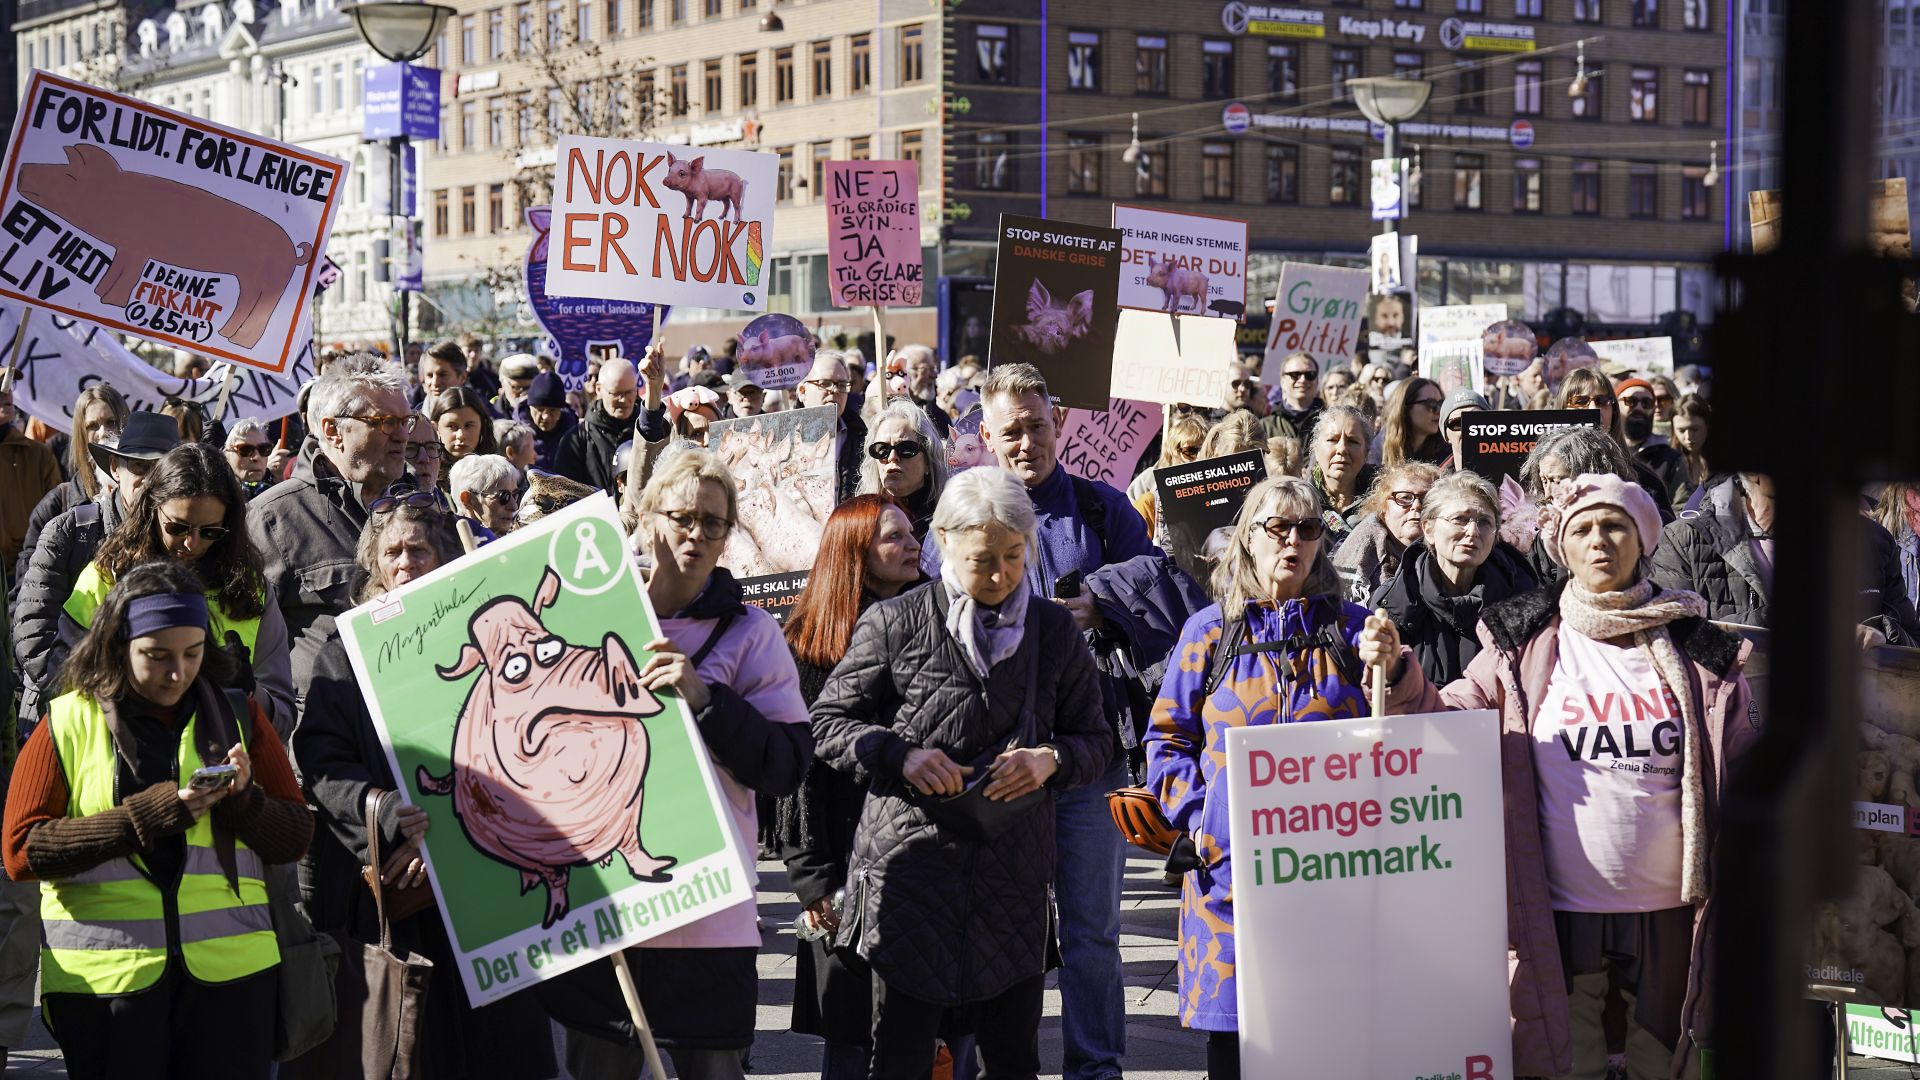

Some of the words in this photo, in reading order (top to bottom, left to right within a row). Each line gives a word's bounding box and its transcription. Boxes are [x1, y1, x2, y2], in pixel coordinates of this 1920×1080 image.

[1339, 15, 1380, 40] Keep
[1381, 18, 1395, 37] it
[1396, 20, 1425, 43] dry
[32, 87, 107, 143] FOR
[109, 107, 178, 159] LIDT.
[176, 128, 233, 177] FOR
[236, 147, 333, 202] LÆNGE
[566, 148, 665, 208] NOK
[834, 169, 899, 199] NEJ
[1, 200, 62, 246] ET
[562, 213, 638, 275] ER
[840, 233, 885, 262] JA
[1006, 227, 1040, 242] STOP
[1043, 234, 1096, 249] SVIGTET
[1099, 239, 1116, 252] AF
[1136, 230, 1158, 241] HAR
[1161, 233, 1193, 245] INGEN
[1196, 238, 1242, 252] STEMME.
[0, 242, 70, 300] LIV
[1013, 245, 1065, 262] DANSKE
[1068, 252, 1106, 268] GRISE
[1120, 247, 1156, 266] DET
[1162, 252, 1203, 273] HAR
[1209, 258, 1241, 278] DU.
[156, 269, 220, 298] DENNE
[866, 261, 923, 282] GLADE
[135, 281, 222, 321] FIRKANT
[559, 303, 572, 314] for
[575, 304, 585, 313] et
[587, 303, 605, 313] rent
[608, 303, 647, 315] landskab
[1288, 281, 1358, 320] Grøn
[1271, 318, 1349, 357] Politik
[765, 367, 795, 378] 25.000
[1091, 410, 1134, 453] VALG
[1469, 424, 1506, 436] STOP
[1077, 424, 1118, 466] ELLER
[1165, 471, 1204, 487] GRISENE
[1205, 467, 1229, 479] SKAL
[1229, 461, 1255, 474] HAVE
[1175, 485, 1206, 499] BEDRE
[1207, 476, 1251, 492] FORHOLD
[1210, 497, 1229, 506] ANIMA
[573, 521, 611, 580] Å
[763, 581, 790, 593] SKAL
[767, 594, 800, 607] PLADS
[1559, 721, 1680, 761] VALG
[1249, 750, 1316, 787] Der
[1324, 752, 1362, 781] er
[1370, 741, 1423, 777] for
[1610, 759, 1640, 773] Zenia
[1643, 763, 1676, 776] Stampe
[1252, 799, 1382, 837] mange
[1390, 785, 1462, 825] svin
[1868, 809, 1900, 826] plan
[1254, 849, 1263, 886] i
[1272, 835, 1452, 884] Danmark.
[472, 949, 520, 992] Der
[526, 936, 553, 970] er
[560, 919, 588, 956] et
[593, 866, 733, 946] Alternativ
[1466, 1055, 1494, 1080] B
